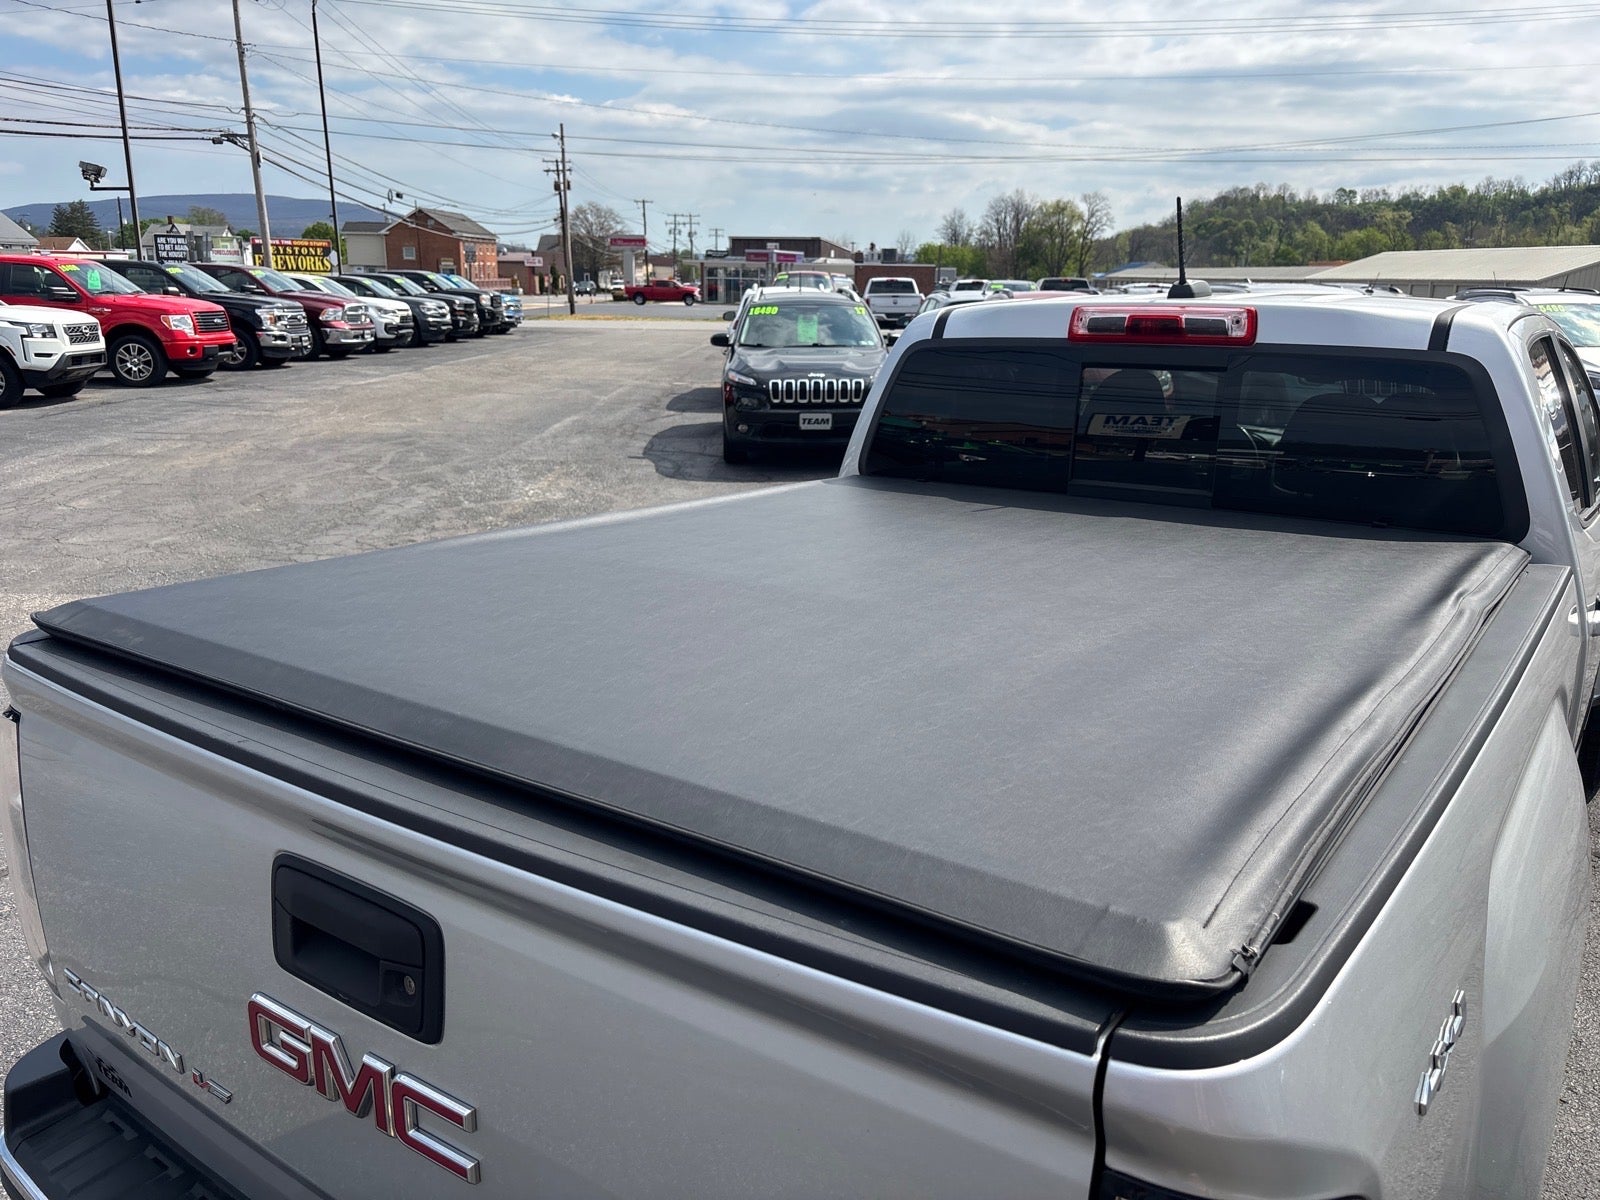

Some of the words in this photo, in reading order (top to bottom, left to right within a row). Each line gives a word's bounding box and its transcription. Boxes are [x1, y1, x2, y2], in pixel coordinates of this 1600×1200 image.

[262, 245, 324, 256] EYSTONE
[254, 254, 332, 272] FREWORKS
[802, 417, 830, 425] TEAM
[247, 991, 482, 1185] GMC
